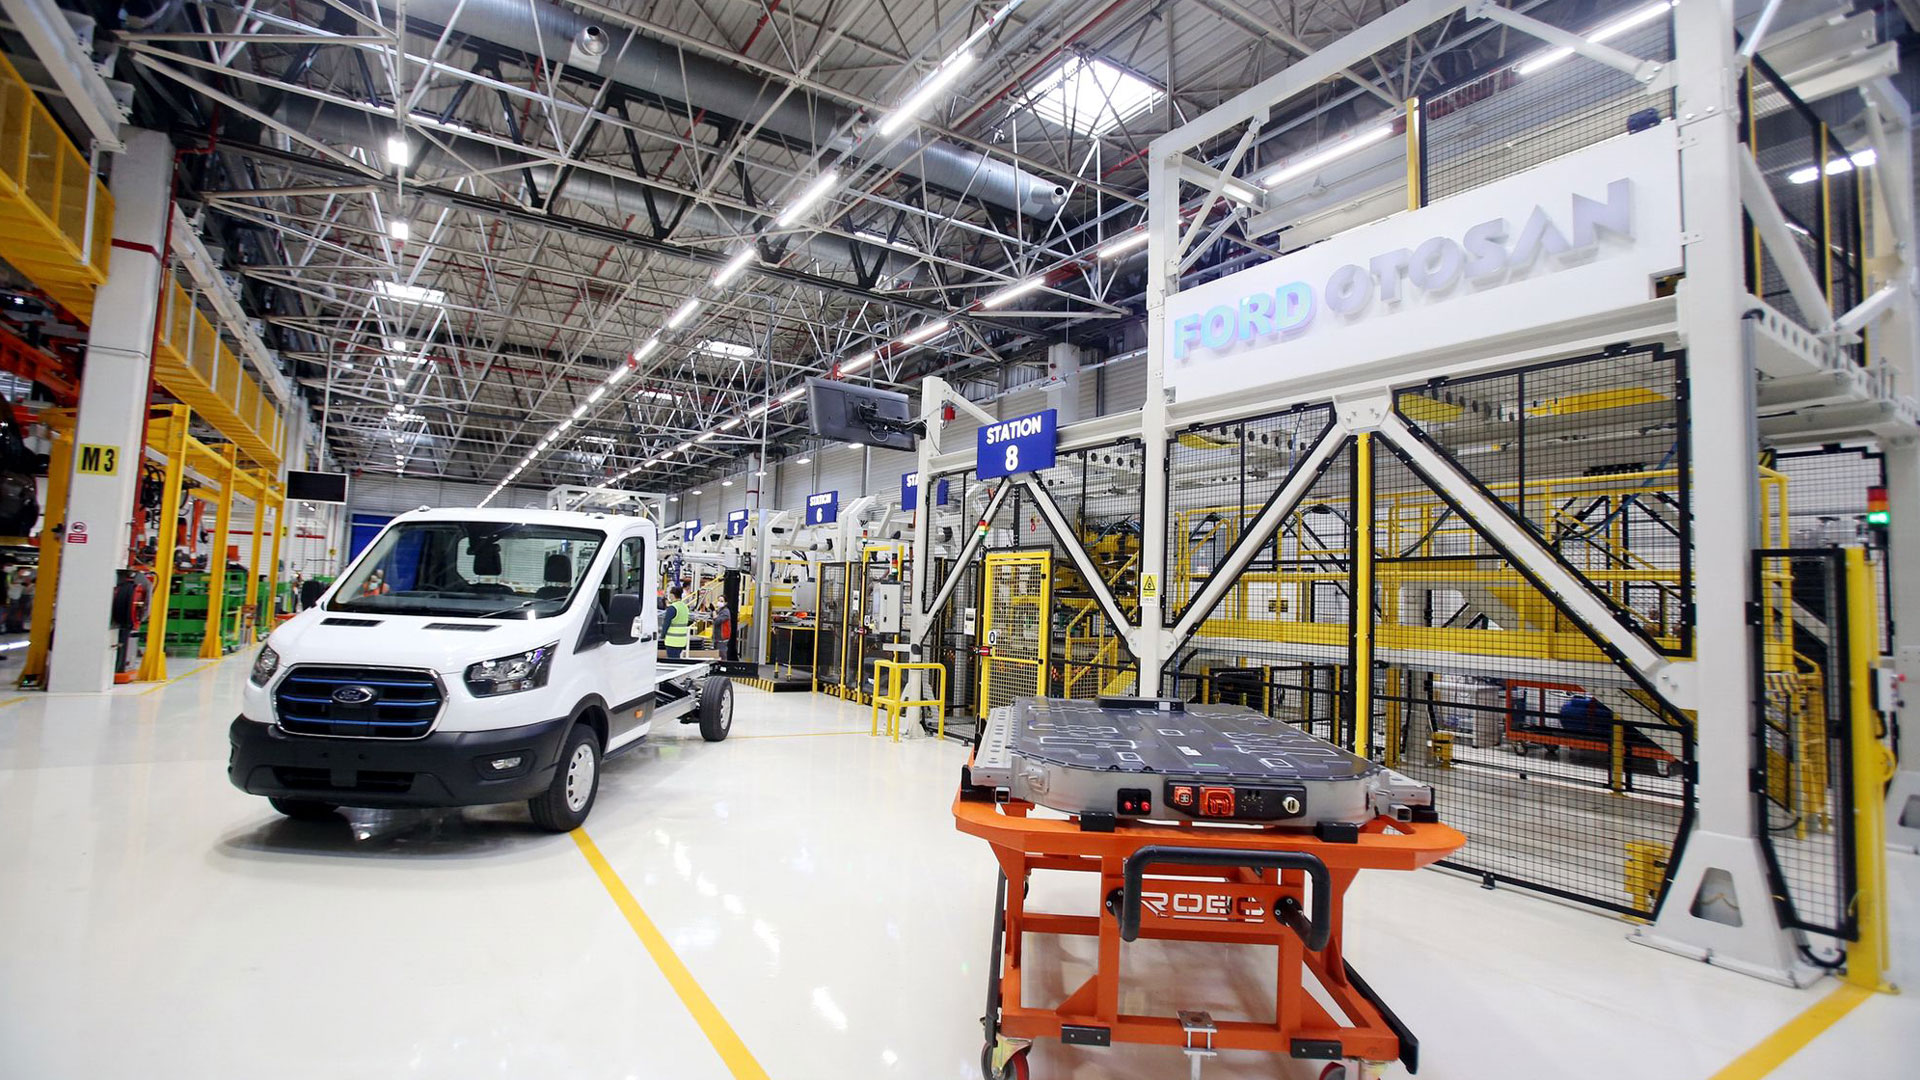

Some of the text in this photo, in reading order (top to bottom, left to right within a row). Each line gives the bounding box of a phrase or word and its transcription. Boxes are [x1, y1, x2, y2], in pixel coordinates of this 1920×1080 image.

[1173, 178, 1634, 360] FORD OTOSAN
[986, 414, 1042, 445] STATION
[1005, 444, 1019, 472] 8
[816, 507, 823, 523] 6
